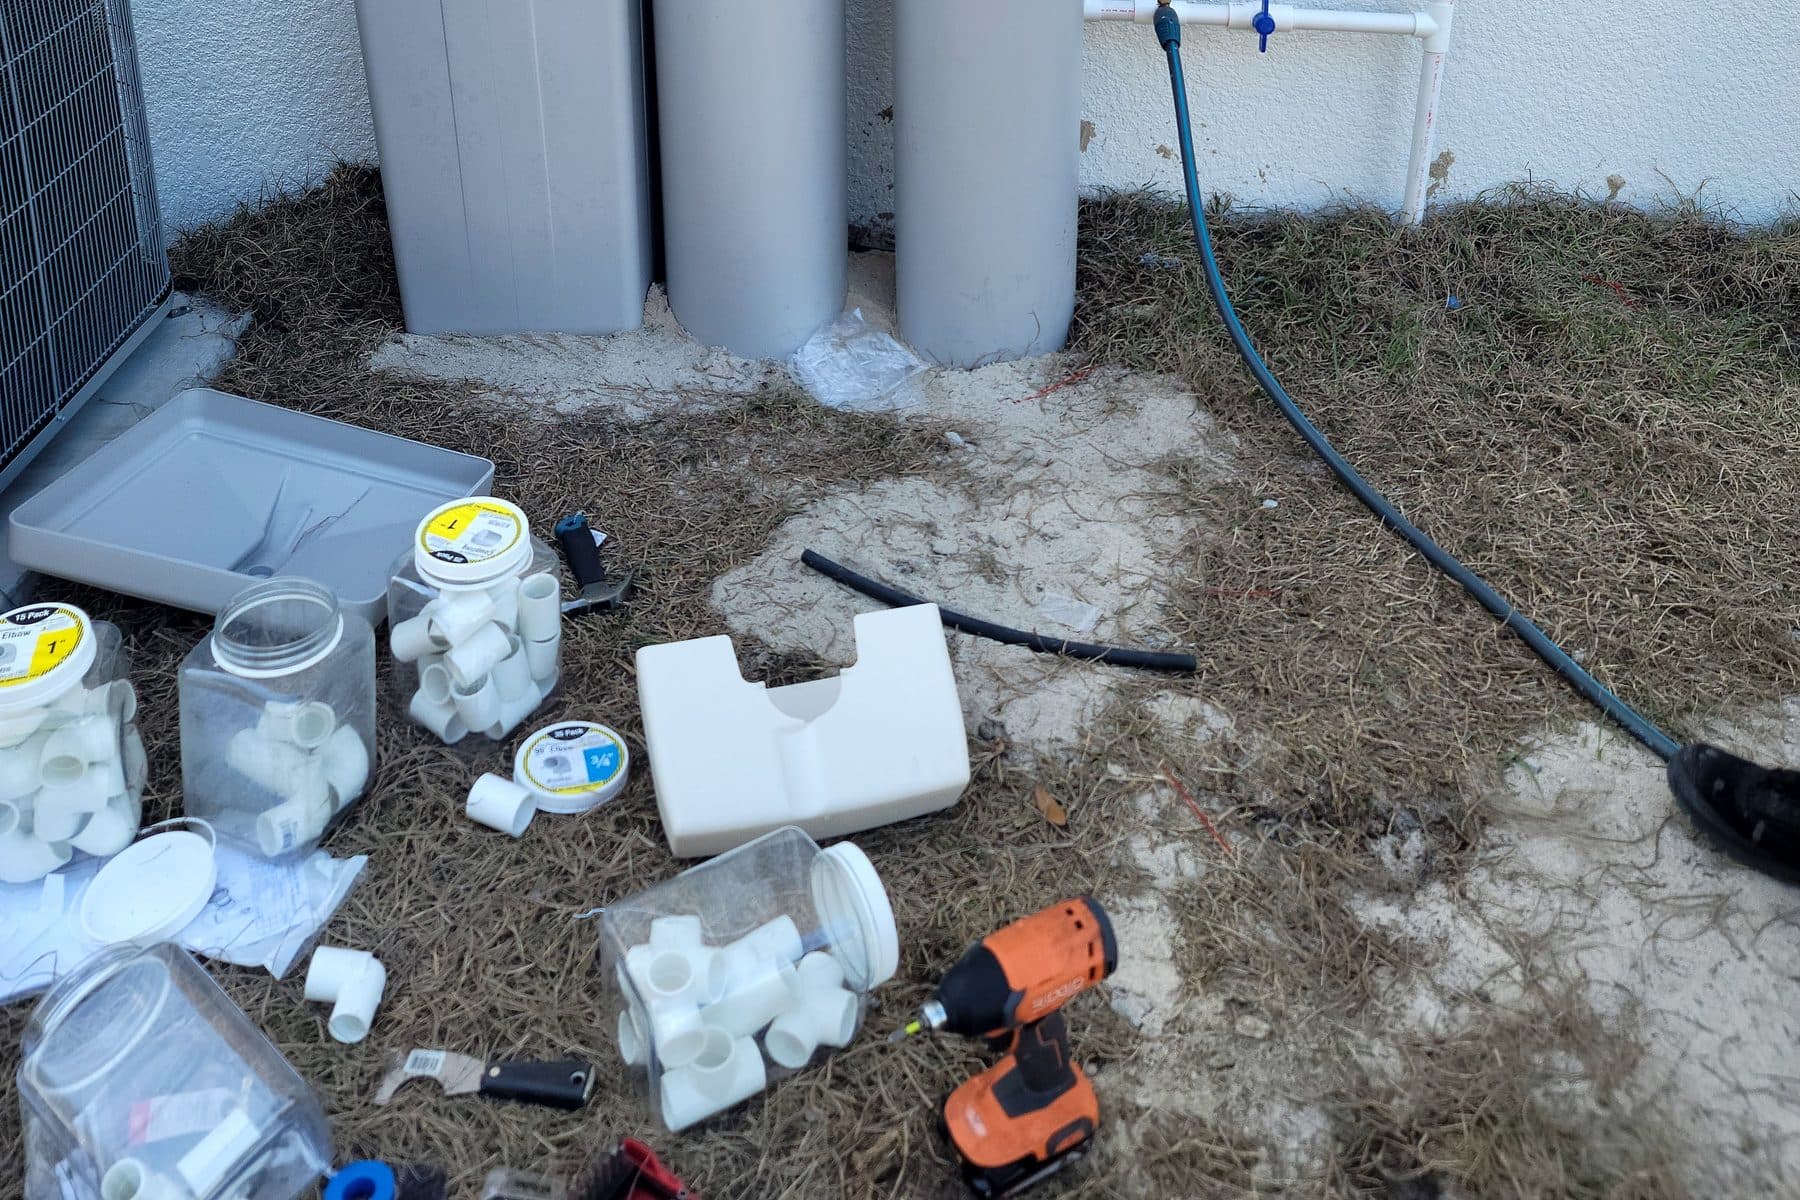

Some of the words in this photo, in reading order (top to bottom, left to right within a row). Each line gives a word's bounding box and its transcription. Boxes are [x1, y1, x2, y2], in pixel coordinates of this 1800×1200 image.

[15, 612, 26, 622] 15
[27, 609, 50, 620] Pack
[1, 629, 32, 640] Elbow
